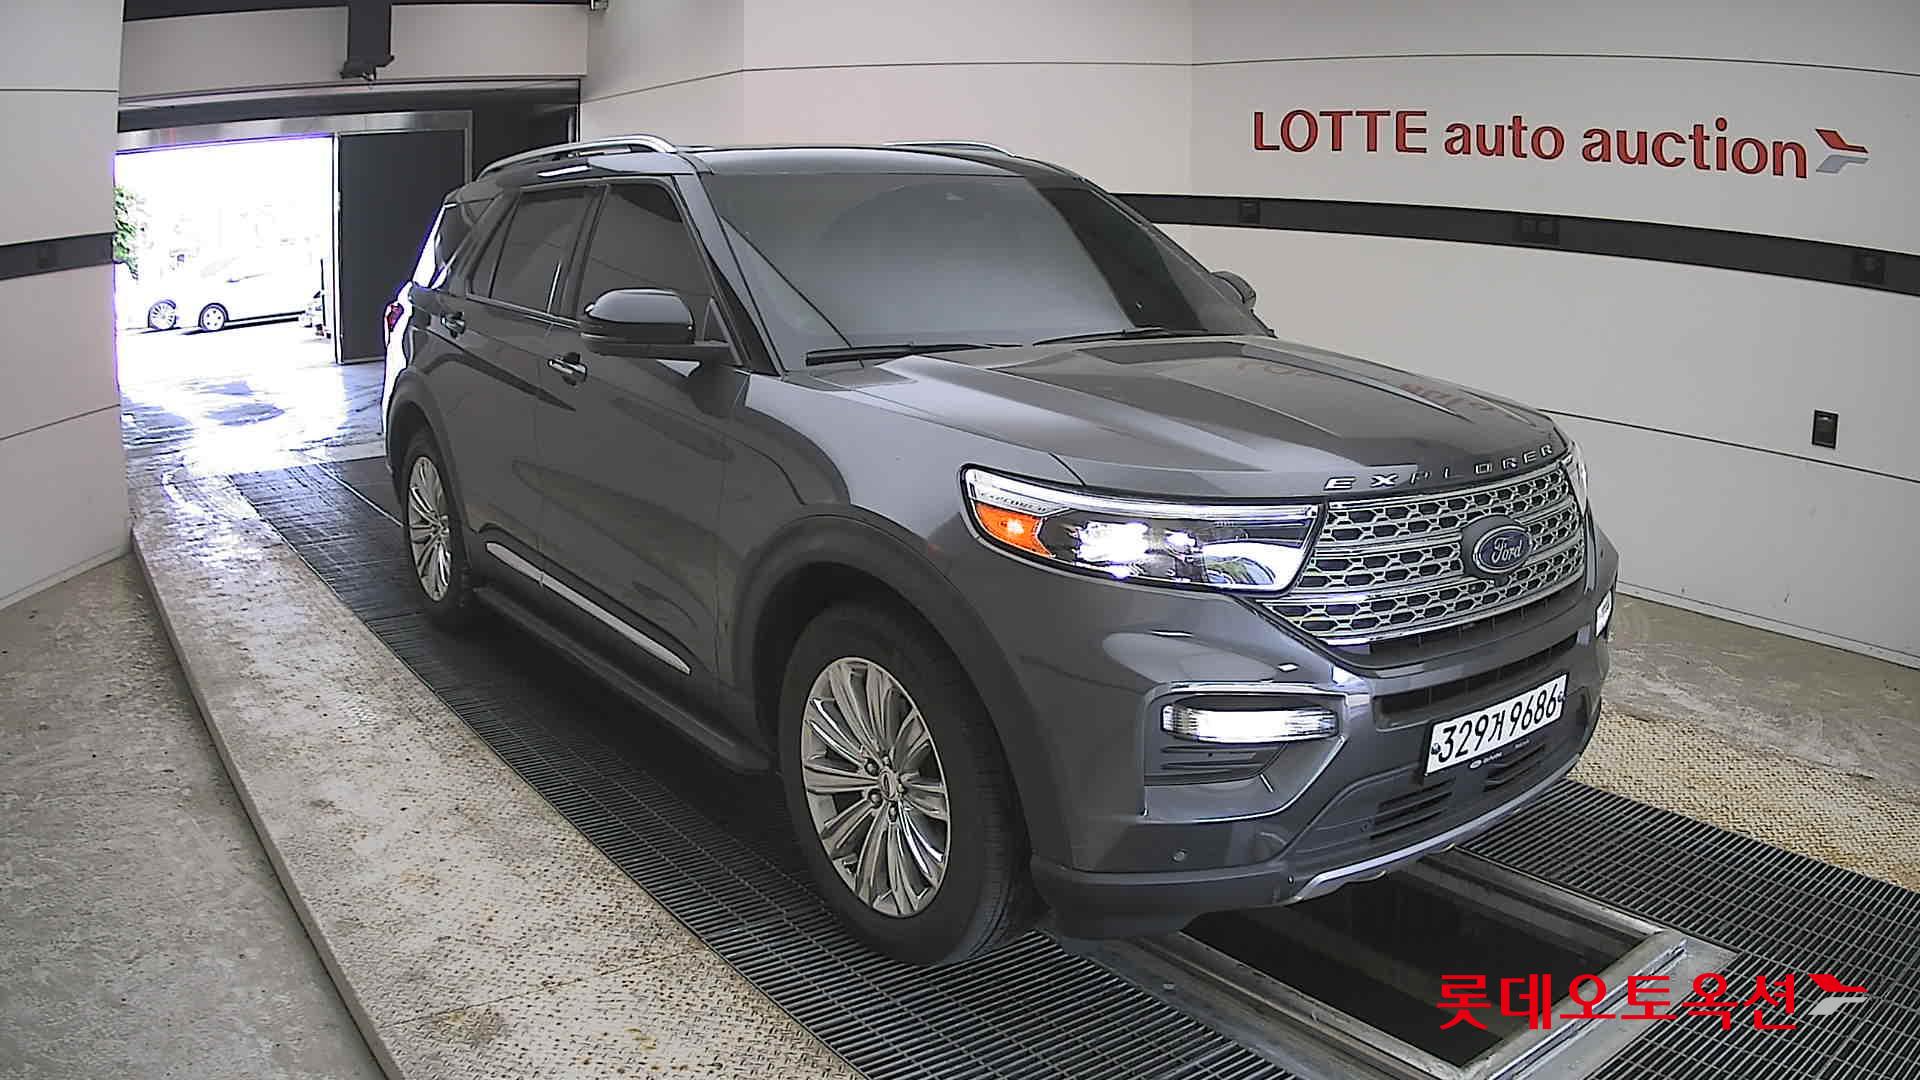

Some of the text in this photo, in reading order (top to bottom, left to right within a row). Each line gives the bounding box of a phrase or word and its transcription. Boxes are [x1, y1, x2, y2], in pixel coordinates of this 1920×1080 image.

[1253, 110, 1808, 180] LOTTE auto auction
[1324, 444, 1554, 491] EXPLORER
[1491, 537, 1522, 563] Ford
